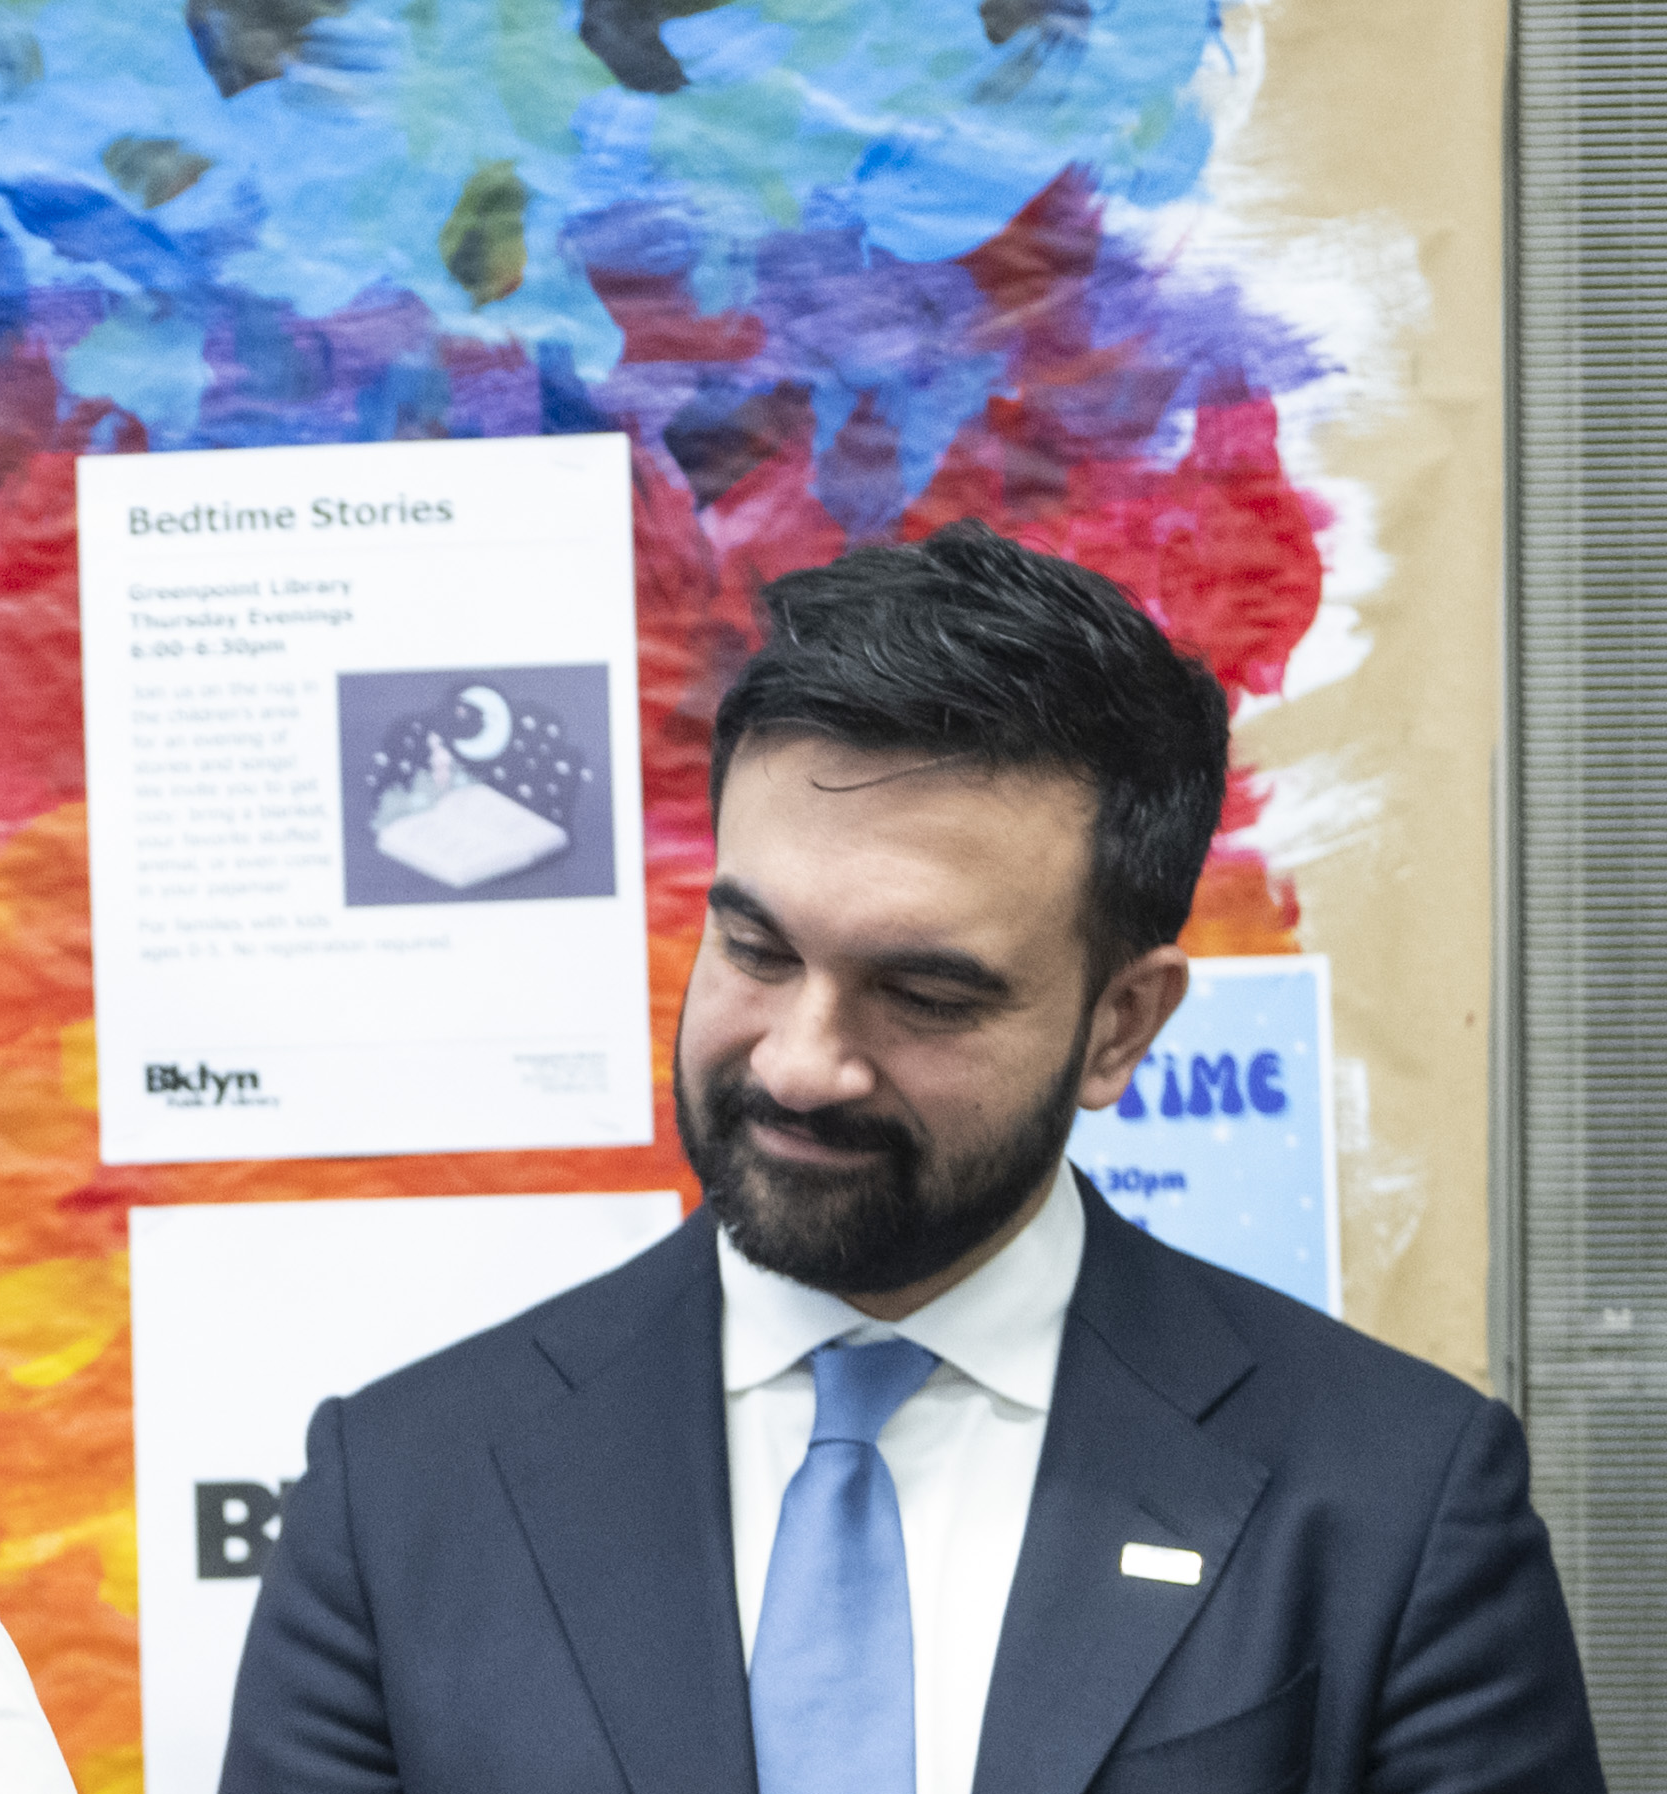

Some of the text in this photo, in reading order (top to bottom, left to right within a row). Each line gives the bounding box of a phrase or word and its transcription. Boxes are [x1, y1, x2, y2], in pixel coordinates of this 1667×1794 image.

[128, 496, 454, 538] Bedtime Stories
[127, 577, 352, 604] Greenpoint Library
[130, 606, 355, 632] Thursday Evenings
[146, 1063, 259, 1106] Bklyn
[194, 1478, 302, 1581] B
